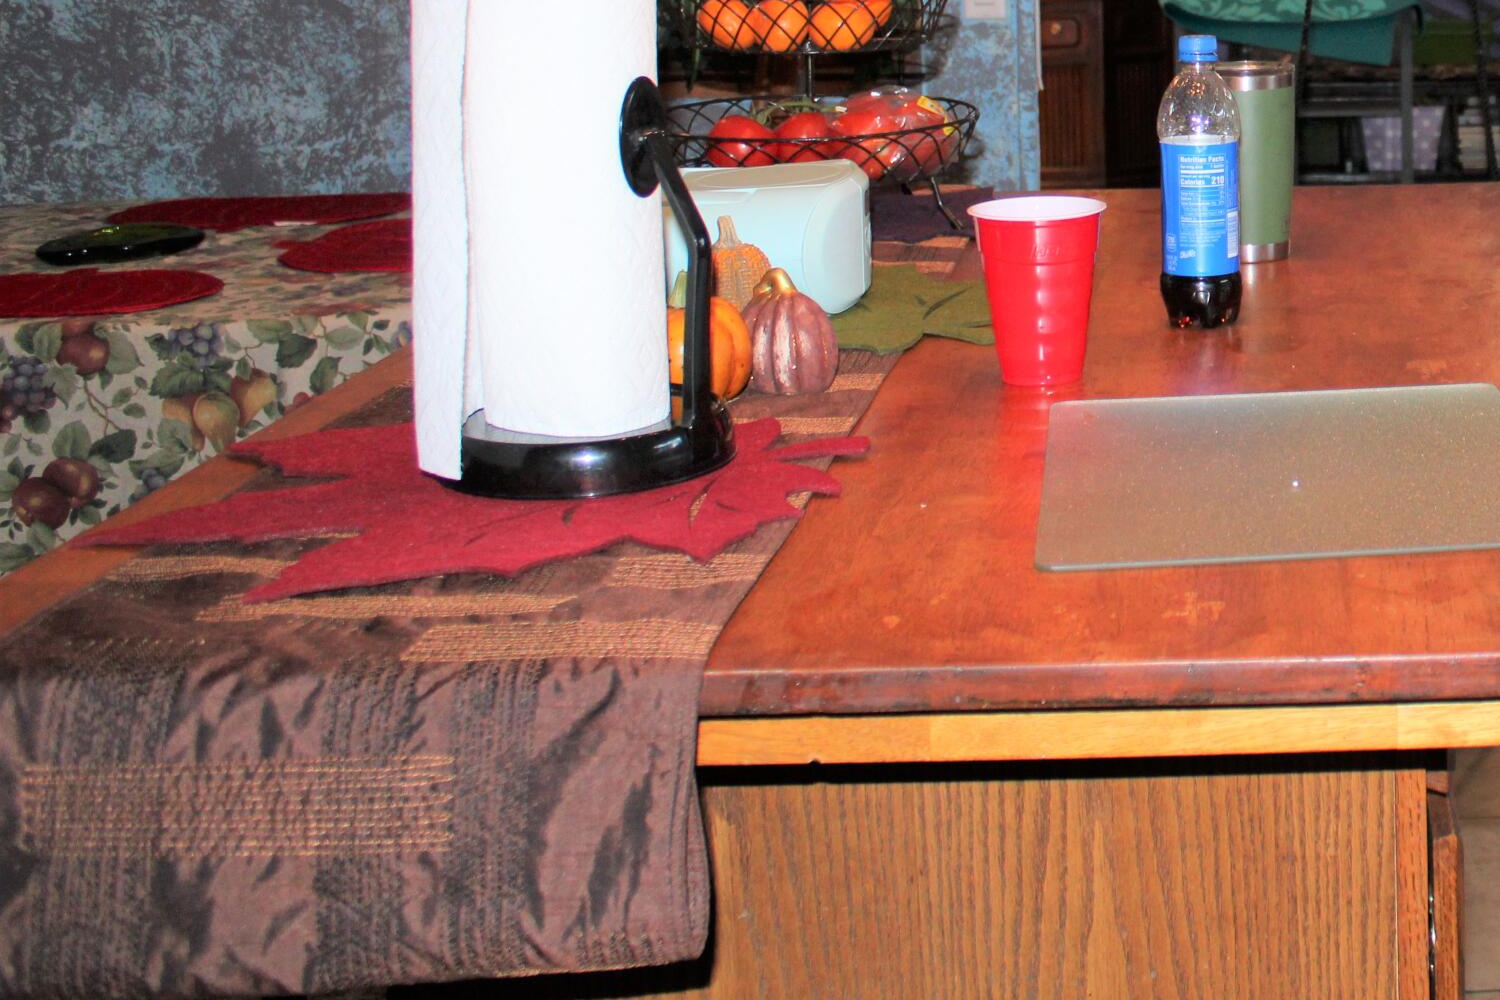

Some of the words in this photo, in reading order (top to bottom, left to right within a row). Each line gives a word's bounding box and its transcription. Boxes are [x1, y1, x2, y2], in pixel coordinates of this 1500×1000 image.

[1180, 155, 1206, 163] Nutrition
[1207, 155, 1224, 163] Facts
[1211, 176, 1224, 185] 210
